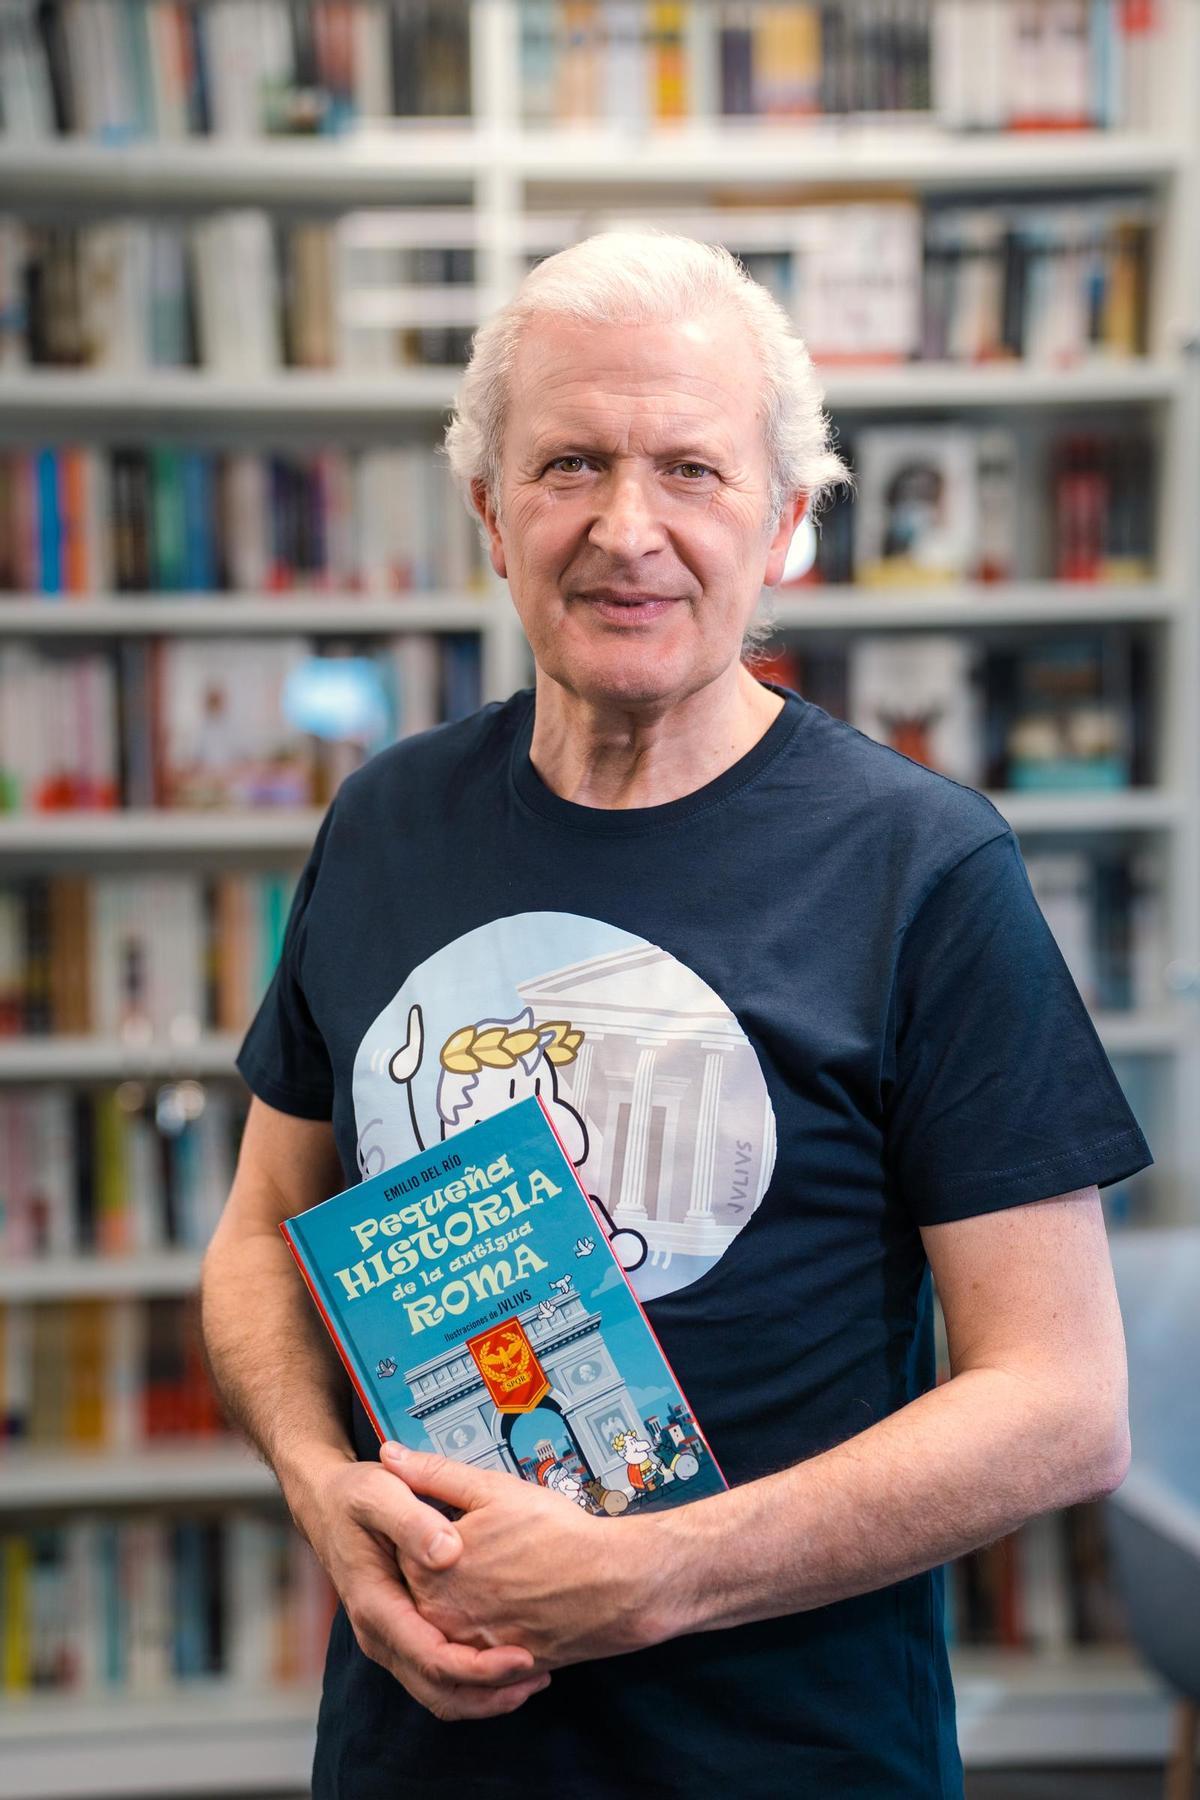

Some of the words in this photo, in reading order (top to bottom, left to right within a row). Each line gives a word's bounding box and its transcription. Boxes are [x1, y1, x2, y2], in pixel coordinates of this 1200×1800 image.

[350, 1153, 515, 1253] Pequeña
[383, 1176, 420, 1202] EMILIO
[421, 1166, 442, 1184] DEL
[443, 1154, 462, 1172] RÍO
[727, 1140, 752, 1214] JVLIVS
[334, 1169, 563, 1301] HISTORIA
[392, 1280, 417, 1301] de
[419, 1266, 444, 1286] la
[449, 1221, 533, 1272] antigua
[403, 1243, 549, 1336] ROMA
[489, 1310, 499, 1320] de
[497, 1289, 532, 1315] JVLIVS
[506, 1375, 527, 1389] SPQR
